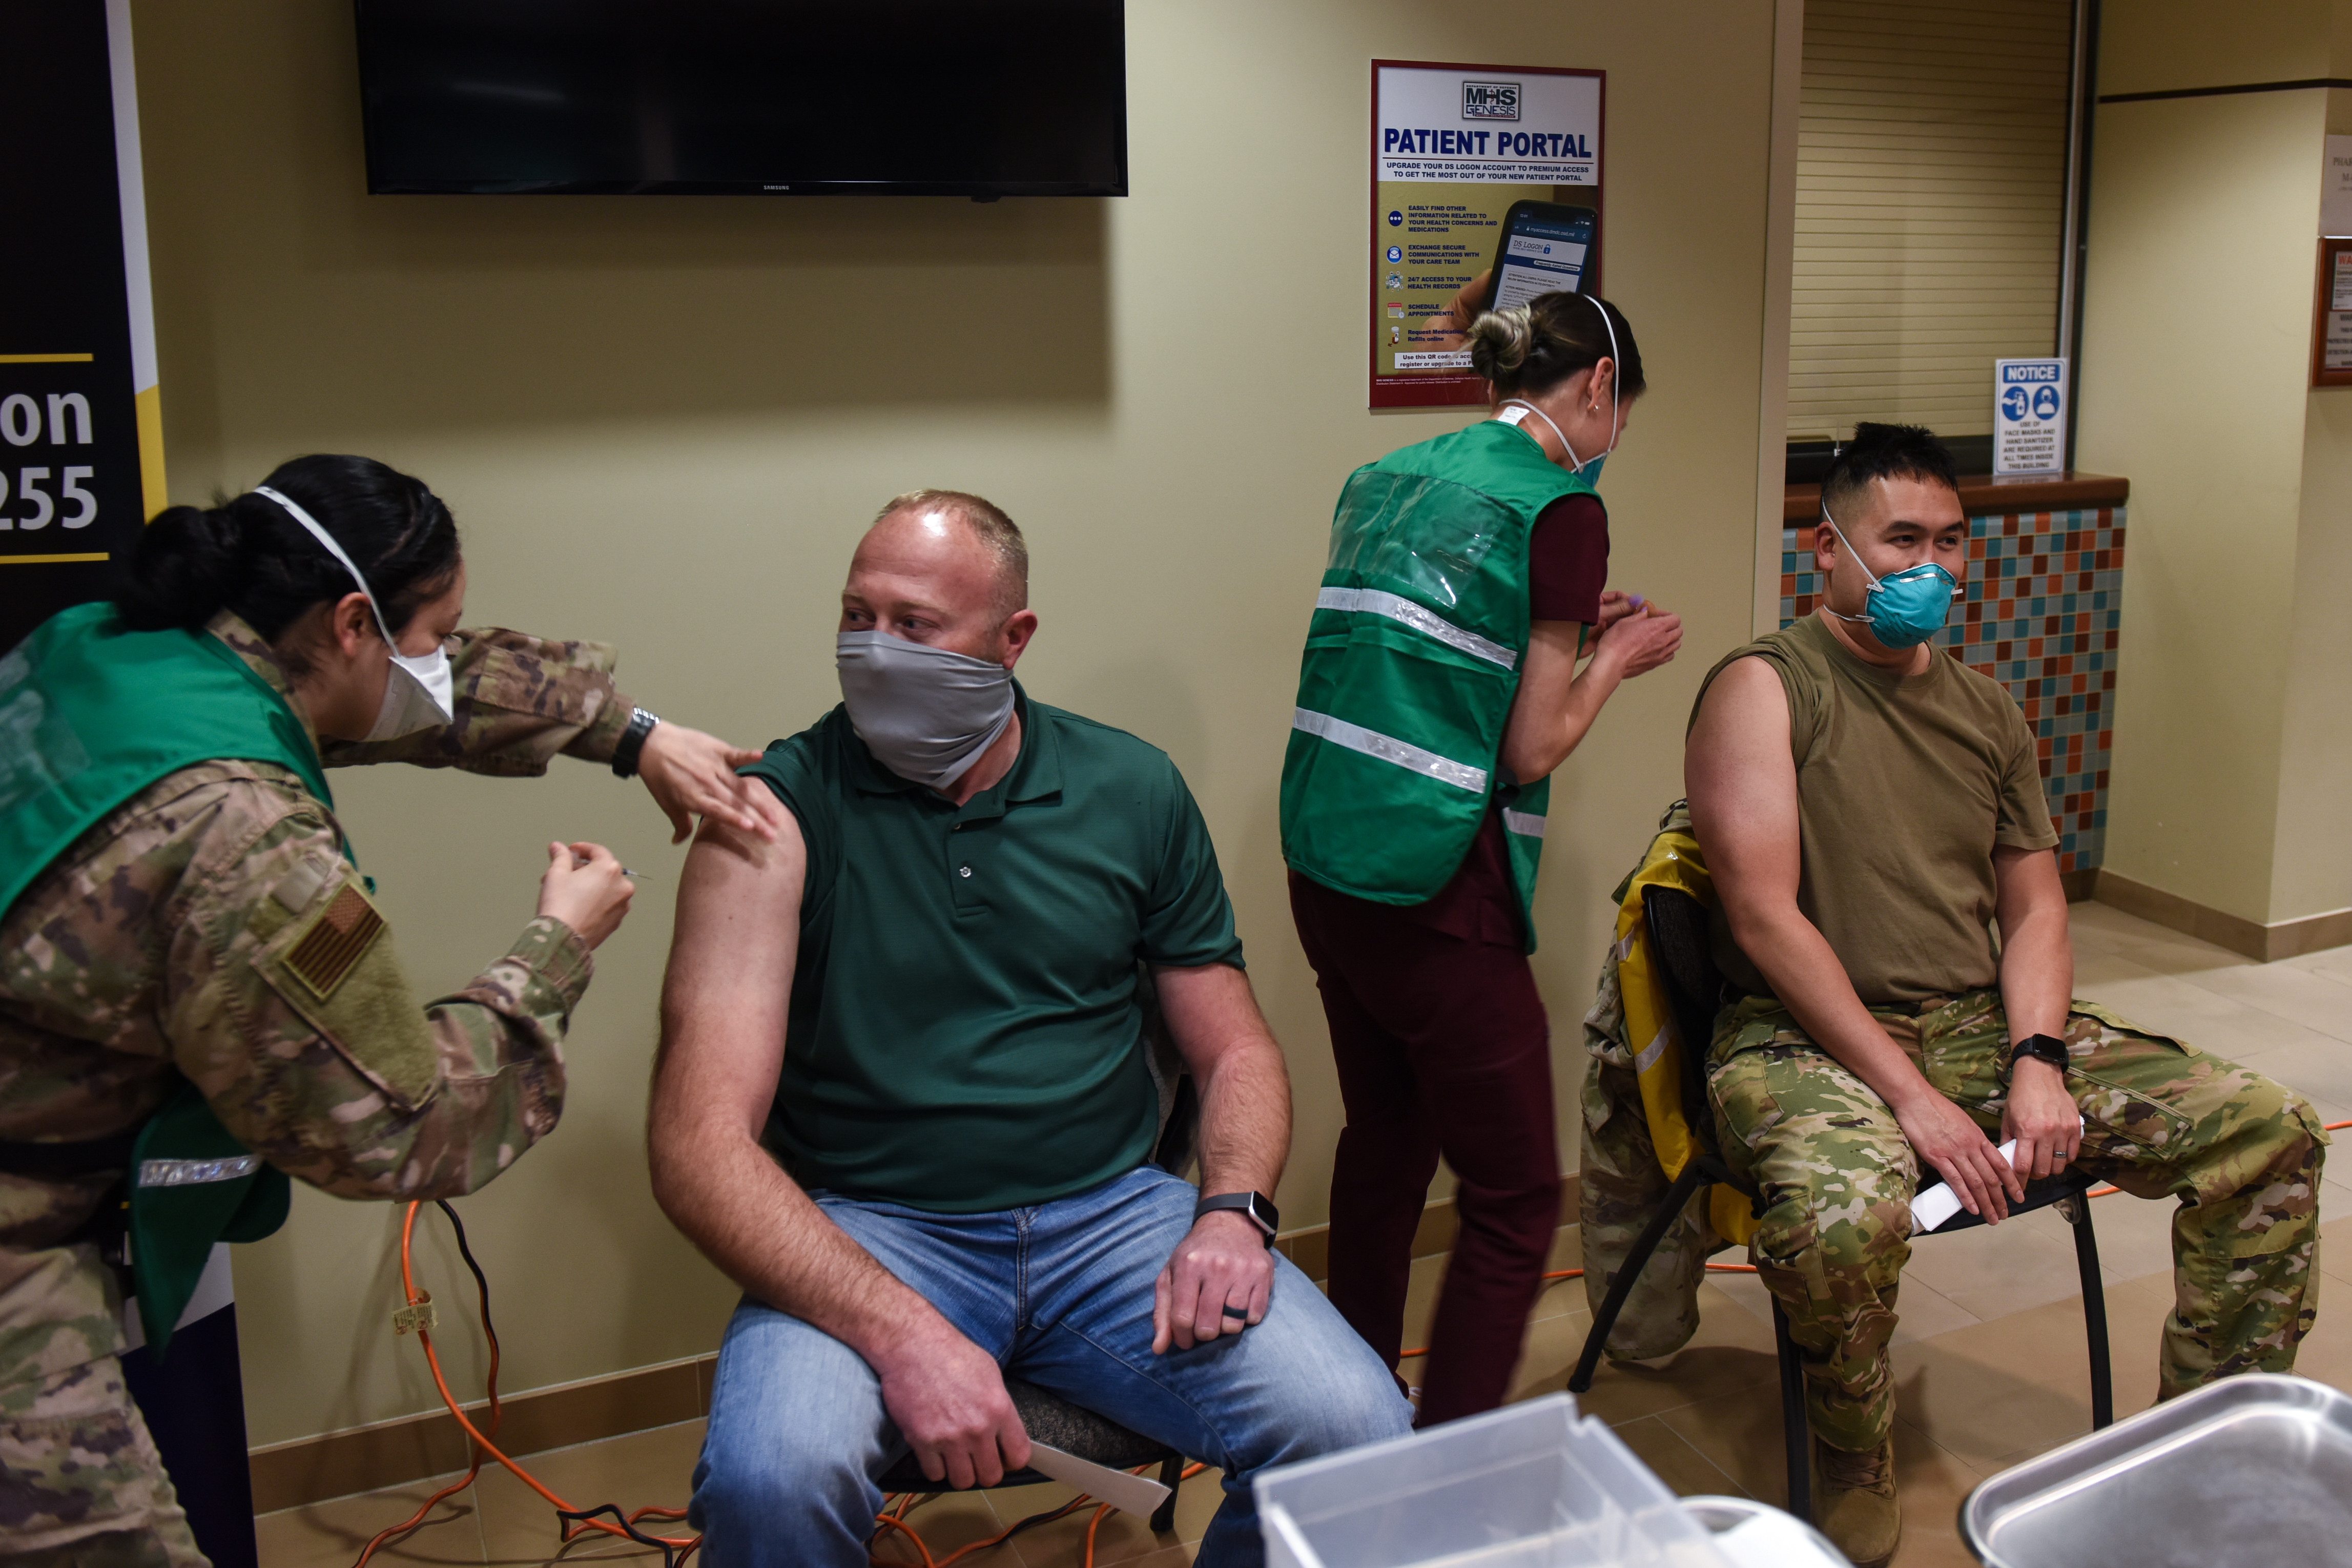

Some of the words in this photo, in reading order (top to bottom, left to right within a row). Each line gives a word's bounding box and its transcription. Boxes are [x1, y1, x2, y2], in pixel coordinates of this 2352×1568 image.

[1466, 88, 1516, 106] MHS
[1466, 104, 1516, 116] GENESIS
[1384, 128, 1490, 155] PATIENT
[1497, 131, 1592, 158] PORTAL
[2008, 366, 2056, 381] NOTICE
[0, 393, 93, 446] on
